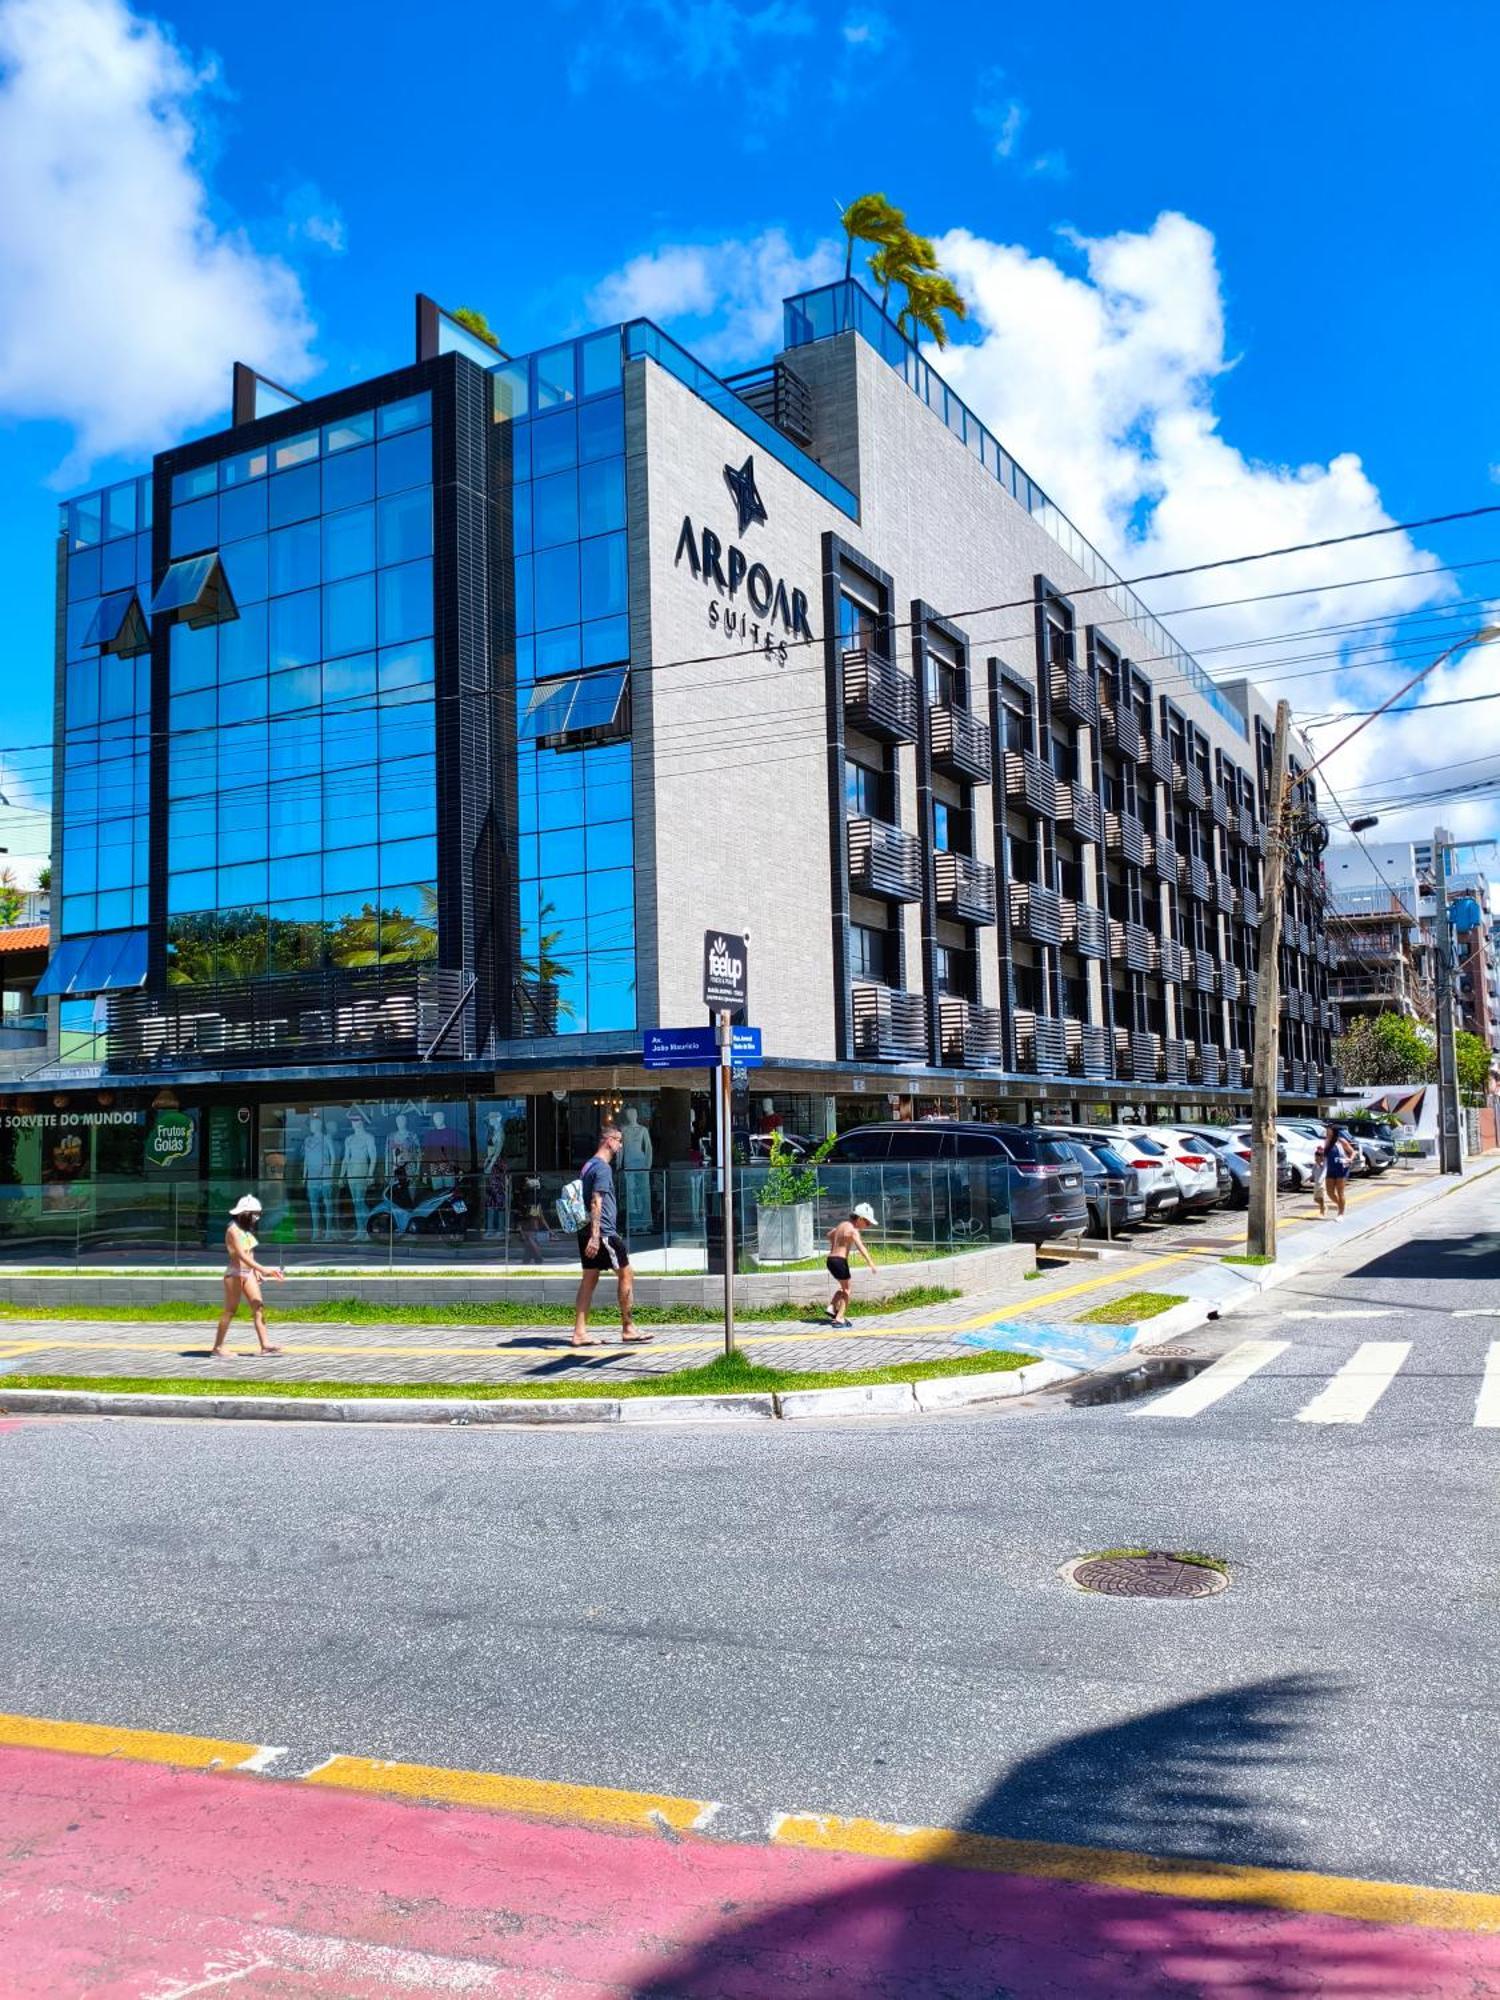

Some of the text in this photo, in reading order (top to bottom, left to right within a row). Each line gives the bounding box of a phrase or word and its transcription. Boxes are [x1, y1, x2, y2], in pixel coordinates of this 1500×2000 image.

[675, 515, 814, 643] ARPOAR
[4, 1114, 57, 1128] SORVETE
[60, 1113, 79, 1126] DO
[82, 1111, 137, 1126] MUNDO!
[157, 1124, 186, 1137] Frutos
[154, 1137, 184, 1152] Goiás
